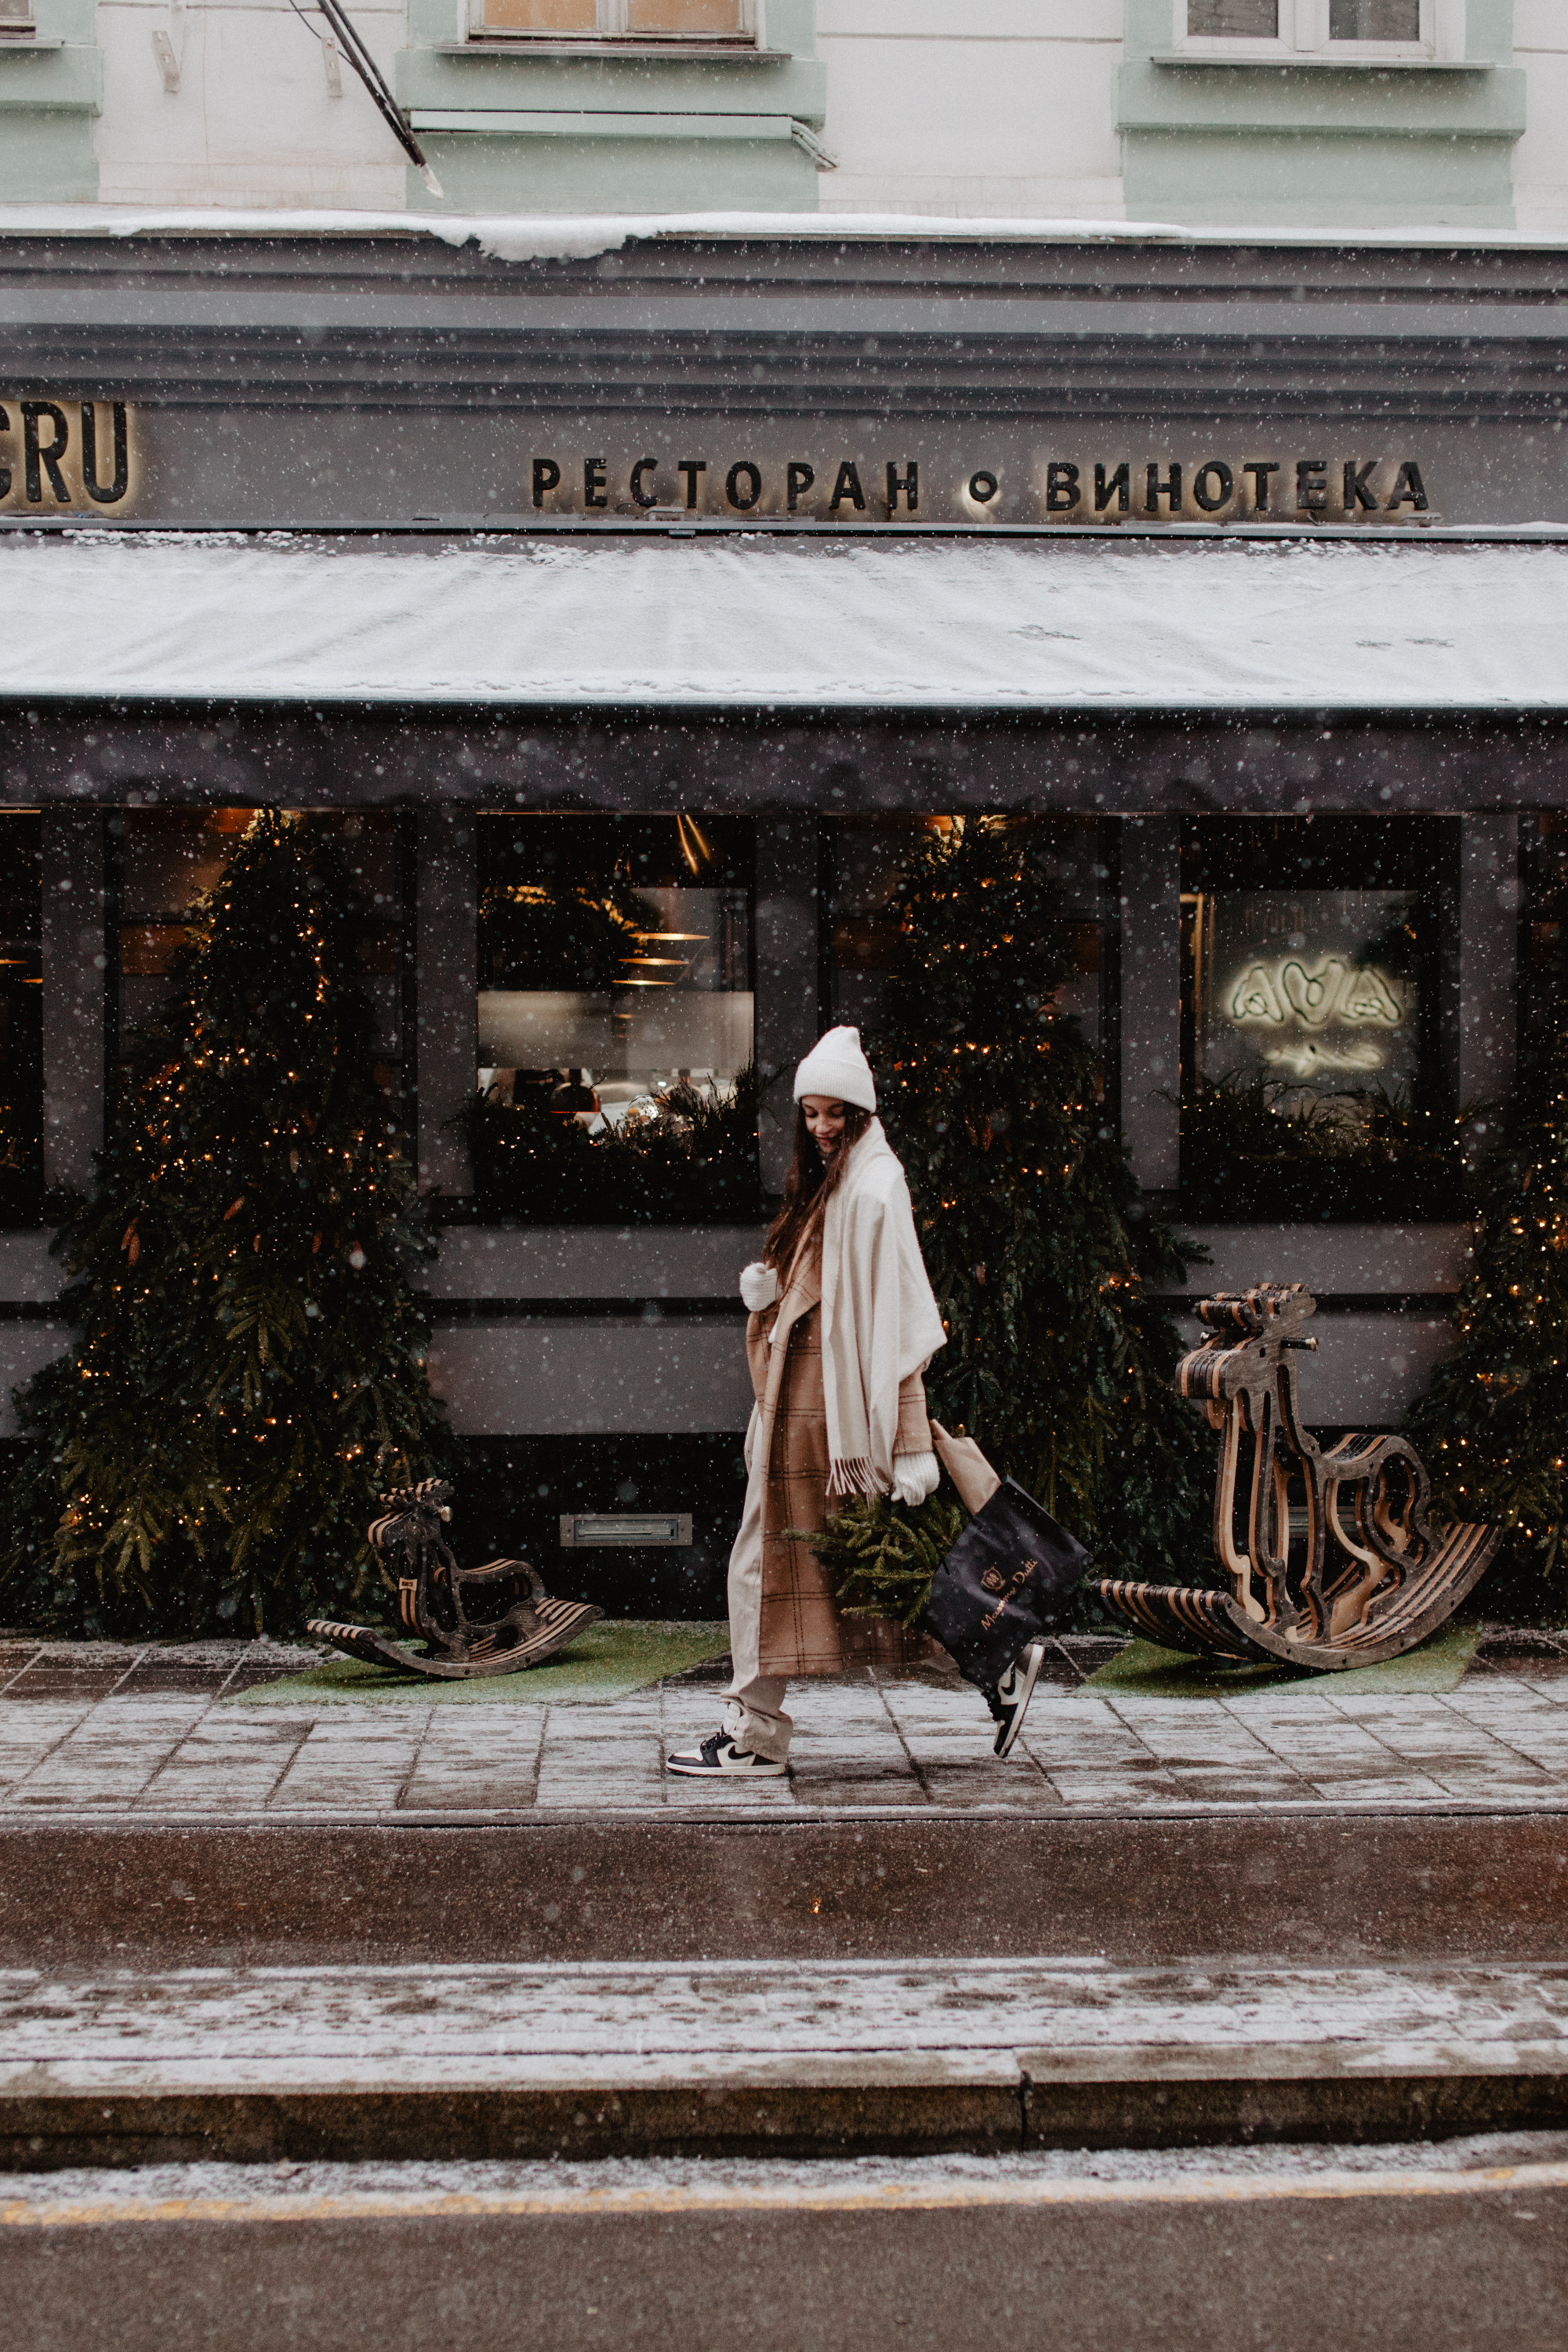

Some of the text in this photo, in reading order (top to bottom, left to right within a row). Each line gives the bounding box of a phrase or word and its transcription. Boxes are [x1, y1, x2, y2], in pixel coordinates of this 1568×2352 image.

[0, 401, 128, 503] RU
[532, 458, 1429, 511] РЕСТОРАН ВИНОТЕКА
[981, 1559, 1038, 1631] Massimo Dutti
